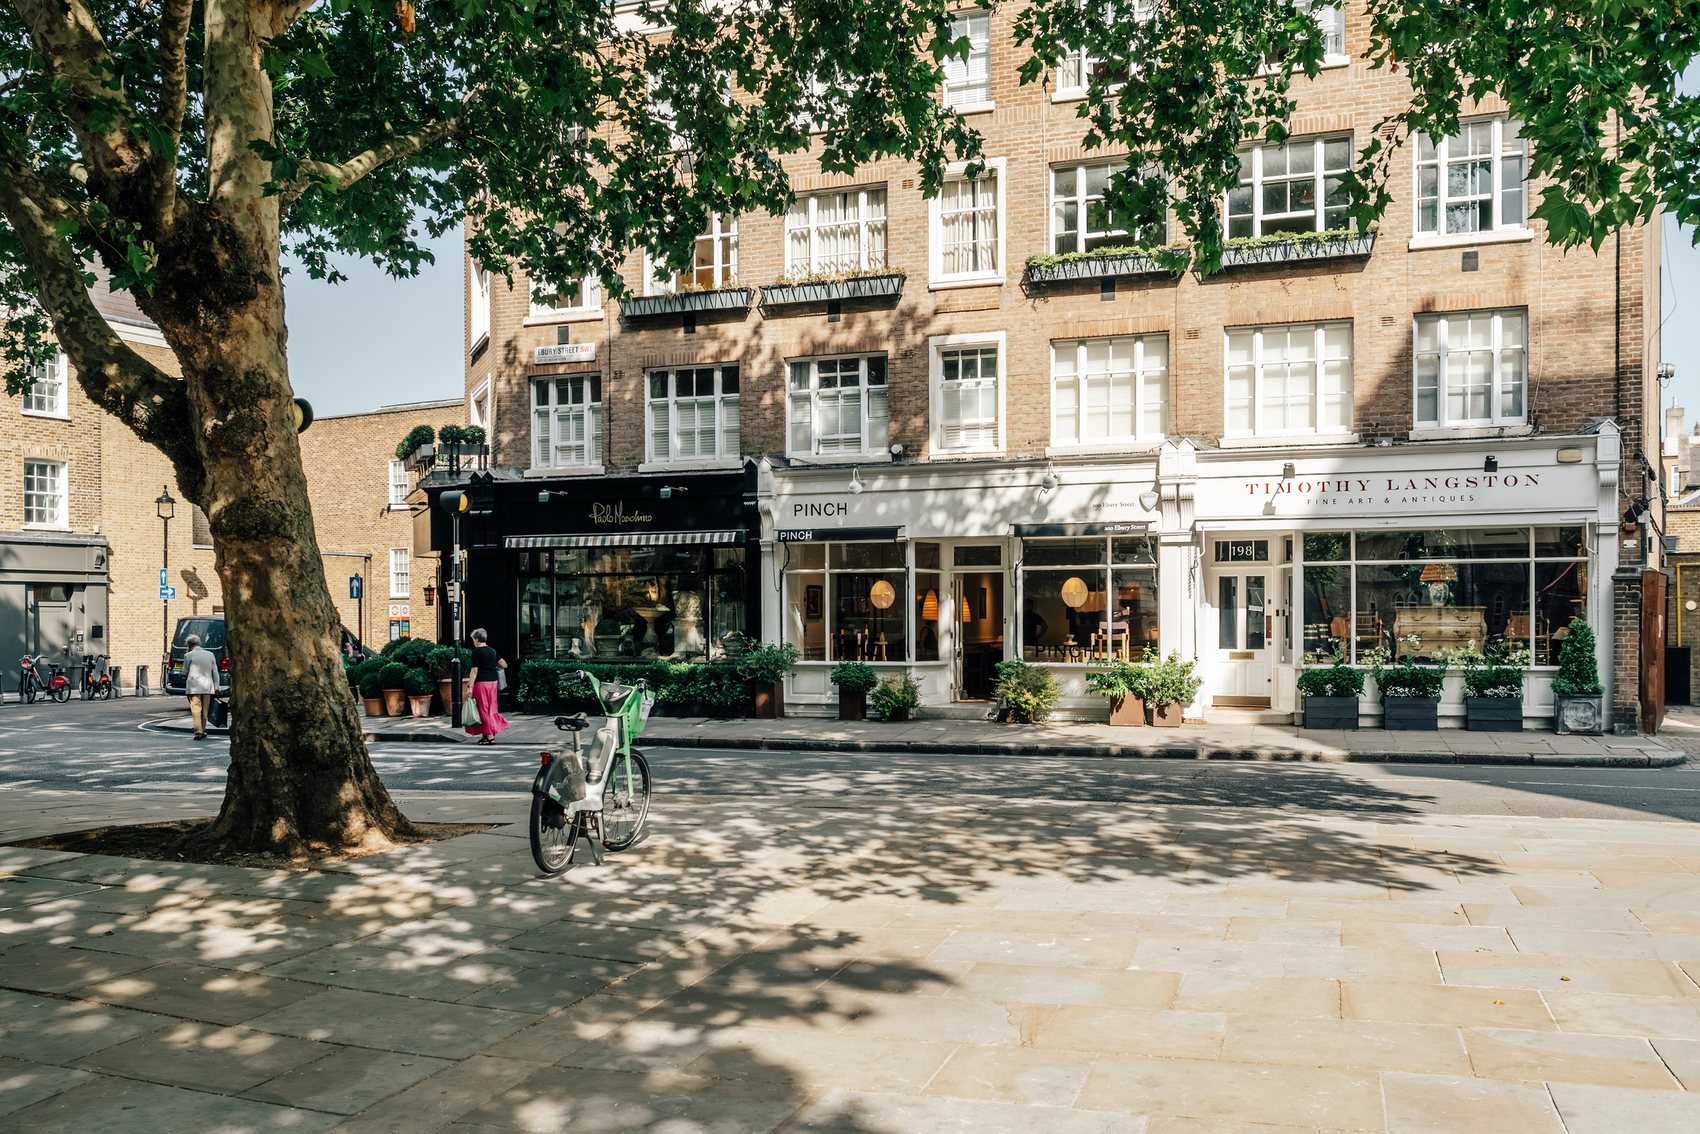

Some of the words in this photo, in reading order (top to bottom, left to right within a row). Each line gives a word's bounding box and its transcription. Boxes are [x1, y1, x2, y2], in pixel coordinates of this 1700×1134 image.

[537, 348, 556, 356] EBURY
[557, 346, 579, 355] STREET
[580, 345, 593, 353] SW1
[1245, 480, 1371, 495] TIMOTHY
[1386, 474, 1540, 491] LANGSTON
[1402, 495, 1475, 503] ANTIQUES
[588, 502, 614, 524] Paolo
[614, 500, 653, 525] Moschino
[794, 502, 847, 516] PINCH
[1114, 524, 1131, 532] Ebury
[780, 531, 813, 541] PINCH
[1231, 545, 1253, 556] 198
[1036, 645, 1096, 658] PINCH
